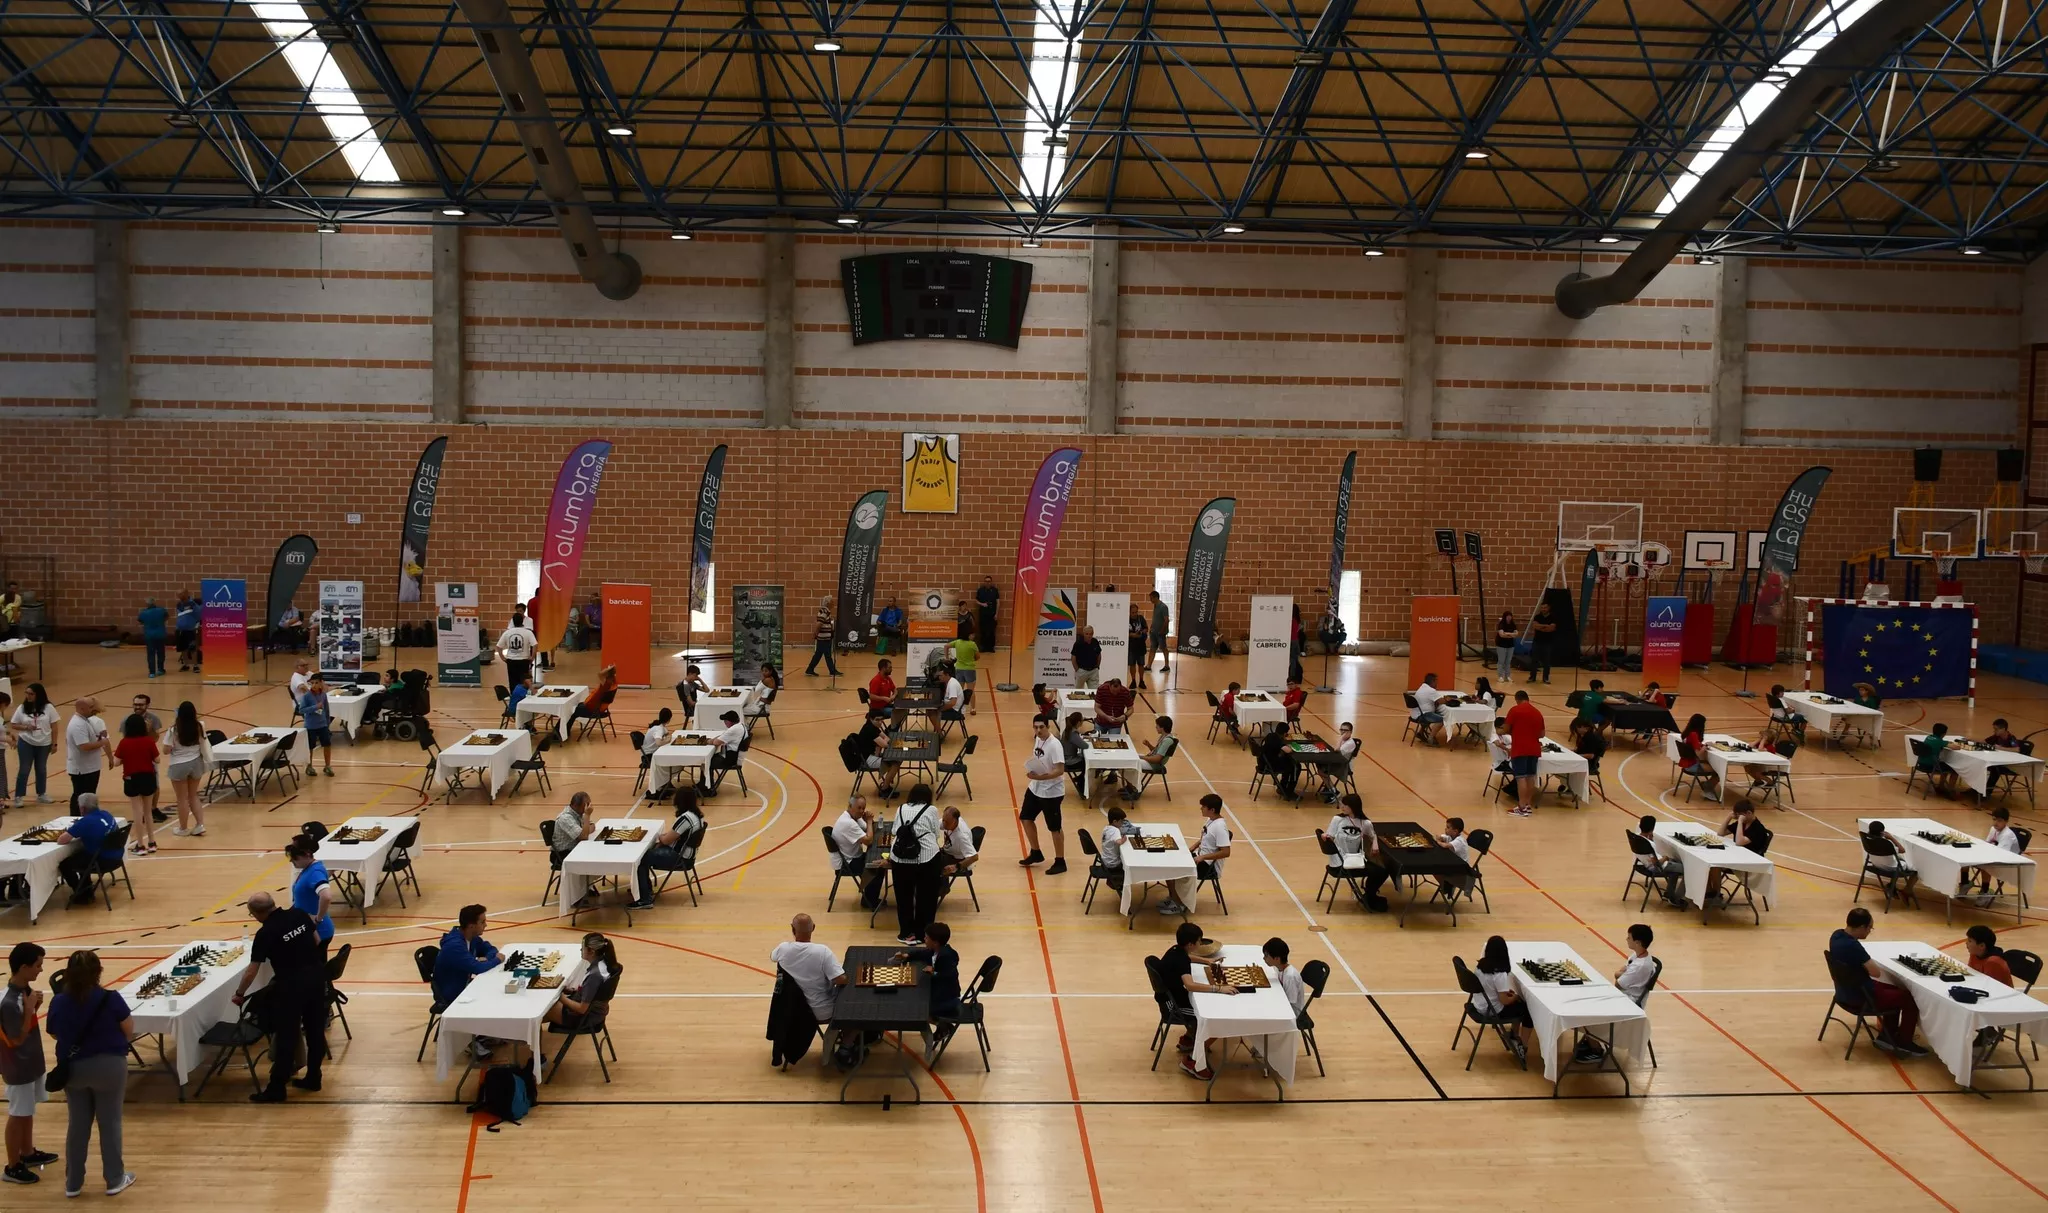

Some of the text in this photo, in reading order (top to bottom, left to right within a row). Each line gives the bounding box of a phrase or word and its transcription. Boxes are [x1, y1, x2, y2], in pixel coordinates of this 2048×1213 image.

[590, 456, 606, 495] ENERGÍA
[1061, 464, 1078, 502] ENERGÍA
[555, 453, 597, 557] alumbra
[1029, 460, 1070, 561] alumbra
[845, 543, 857, 594] FERTILIZANTES
[1189, 549, 1200, 599] FERTILIZANTES
[1178, 645, 1208, 654] defeder
[283, 924, 306, 942] STAFF
